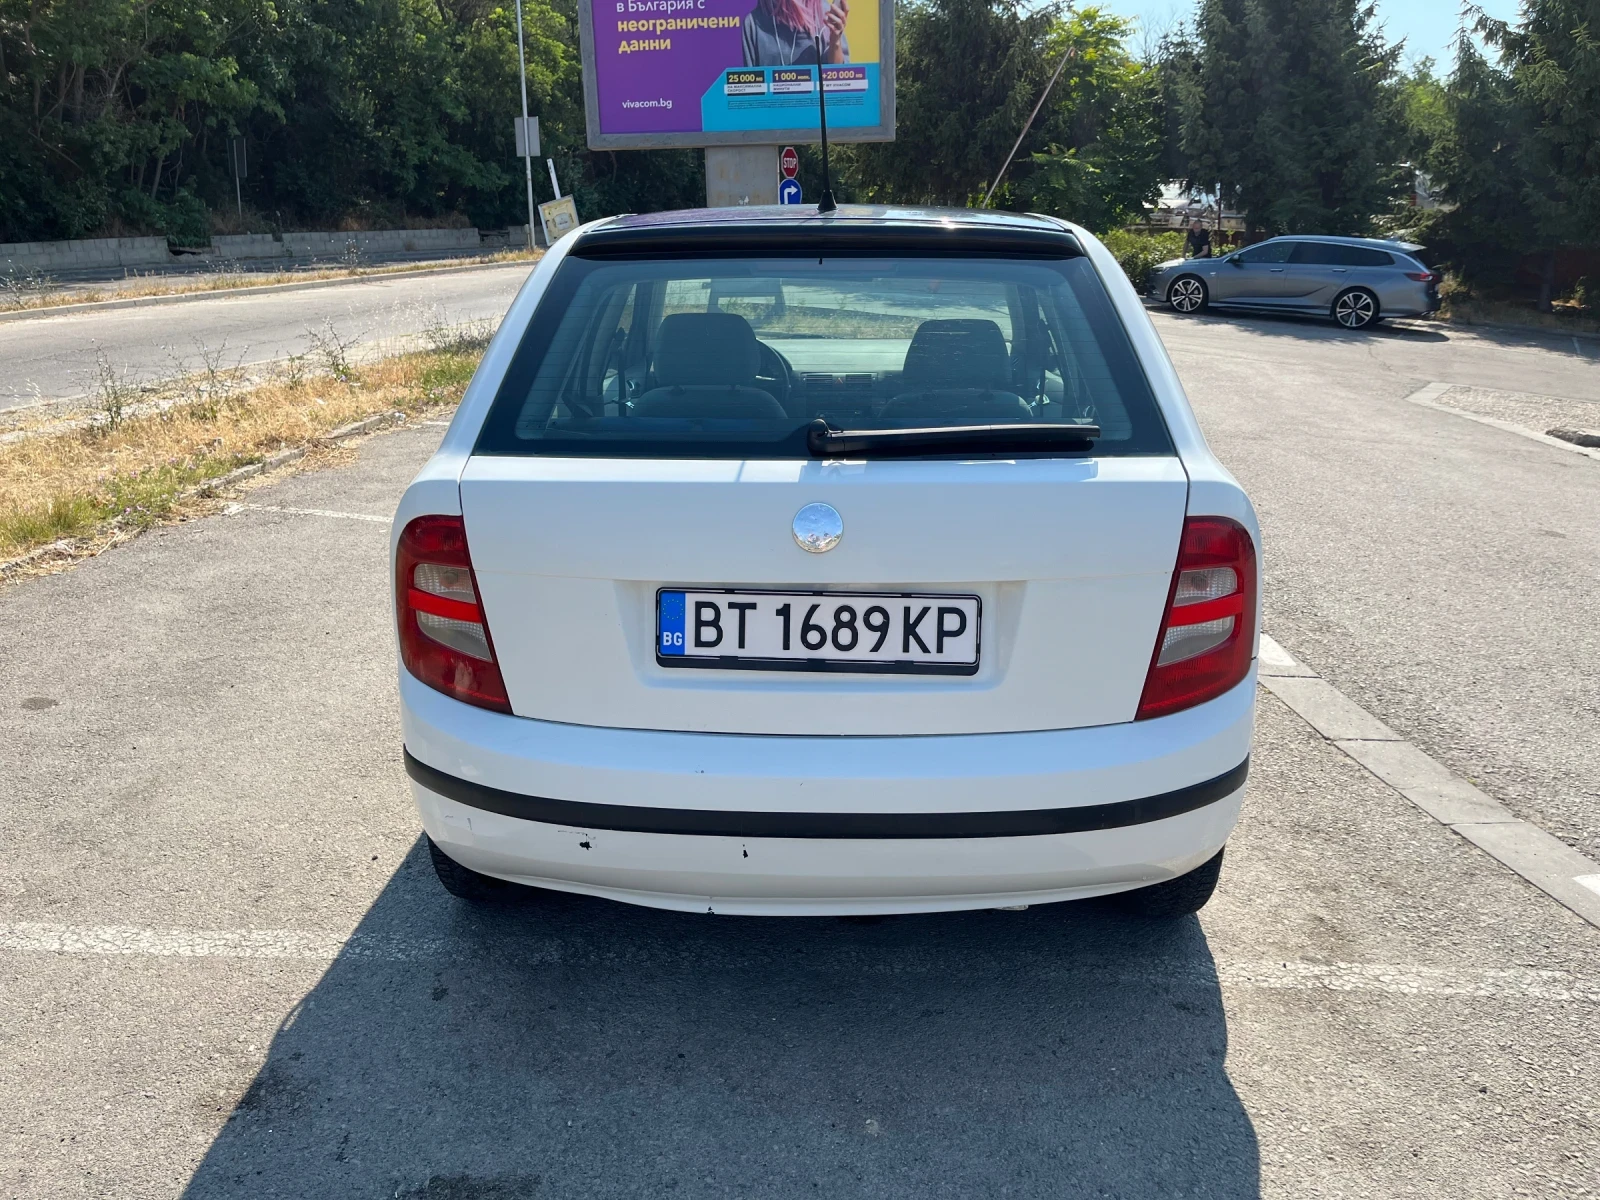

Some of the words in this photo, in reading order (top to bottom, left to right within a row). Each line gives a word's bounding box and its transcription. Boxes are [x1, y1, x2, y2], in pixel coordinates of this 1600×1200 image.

[616, 2, 625, 13] в
[628, 0, 694, 14] България
[617, 16, 740, 35] неограничени
[618, 38, 671, 54] данни
[728, 74, 739, 83] 25
[739, 74, 755, 82] 000
[774, 73, 779, 81] 1
[781, 72, 796, 80] 000
[822, 71, 838, 80] +20
[838, 70, 855, 79] 000
[622, 97, 673, 109] vivacom.bg
[783, 157, 797, 169] STOP
[694, 601, 757, 649] BT
[775, 603, 890, 653] 1689
[902, 606, 967, 654] KP
[662, 631, 683, 646] BG
